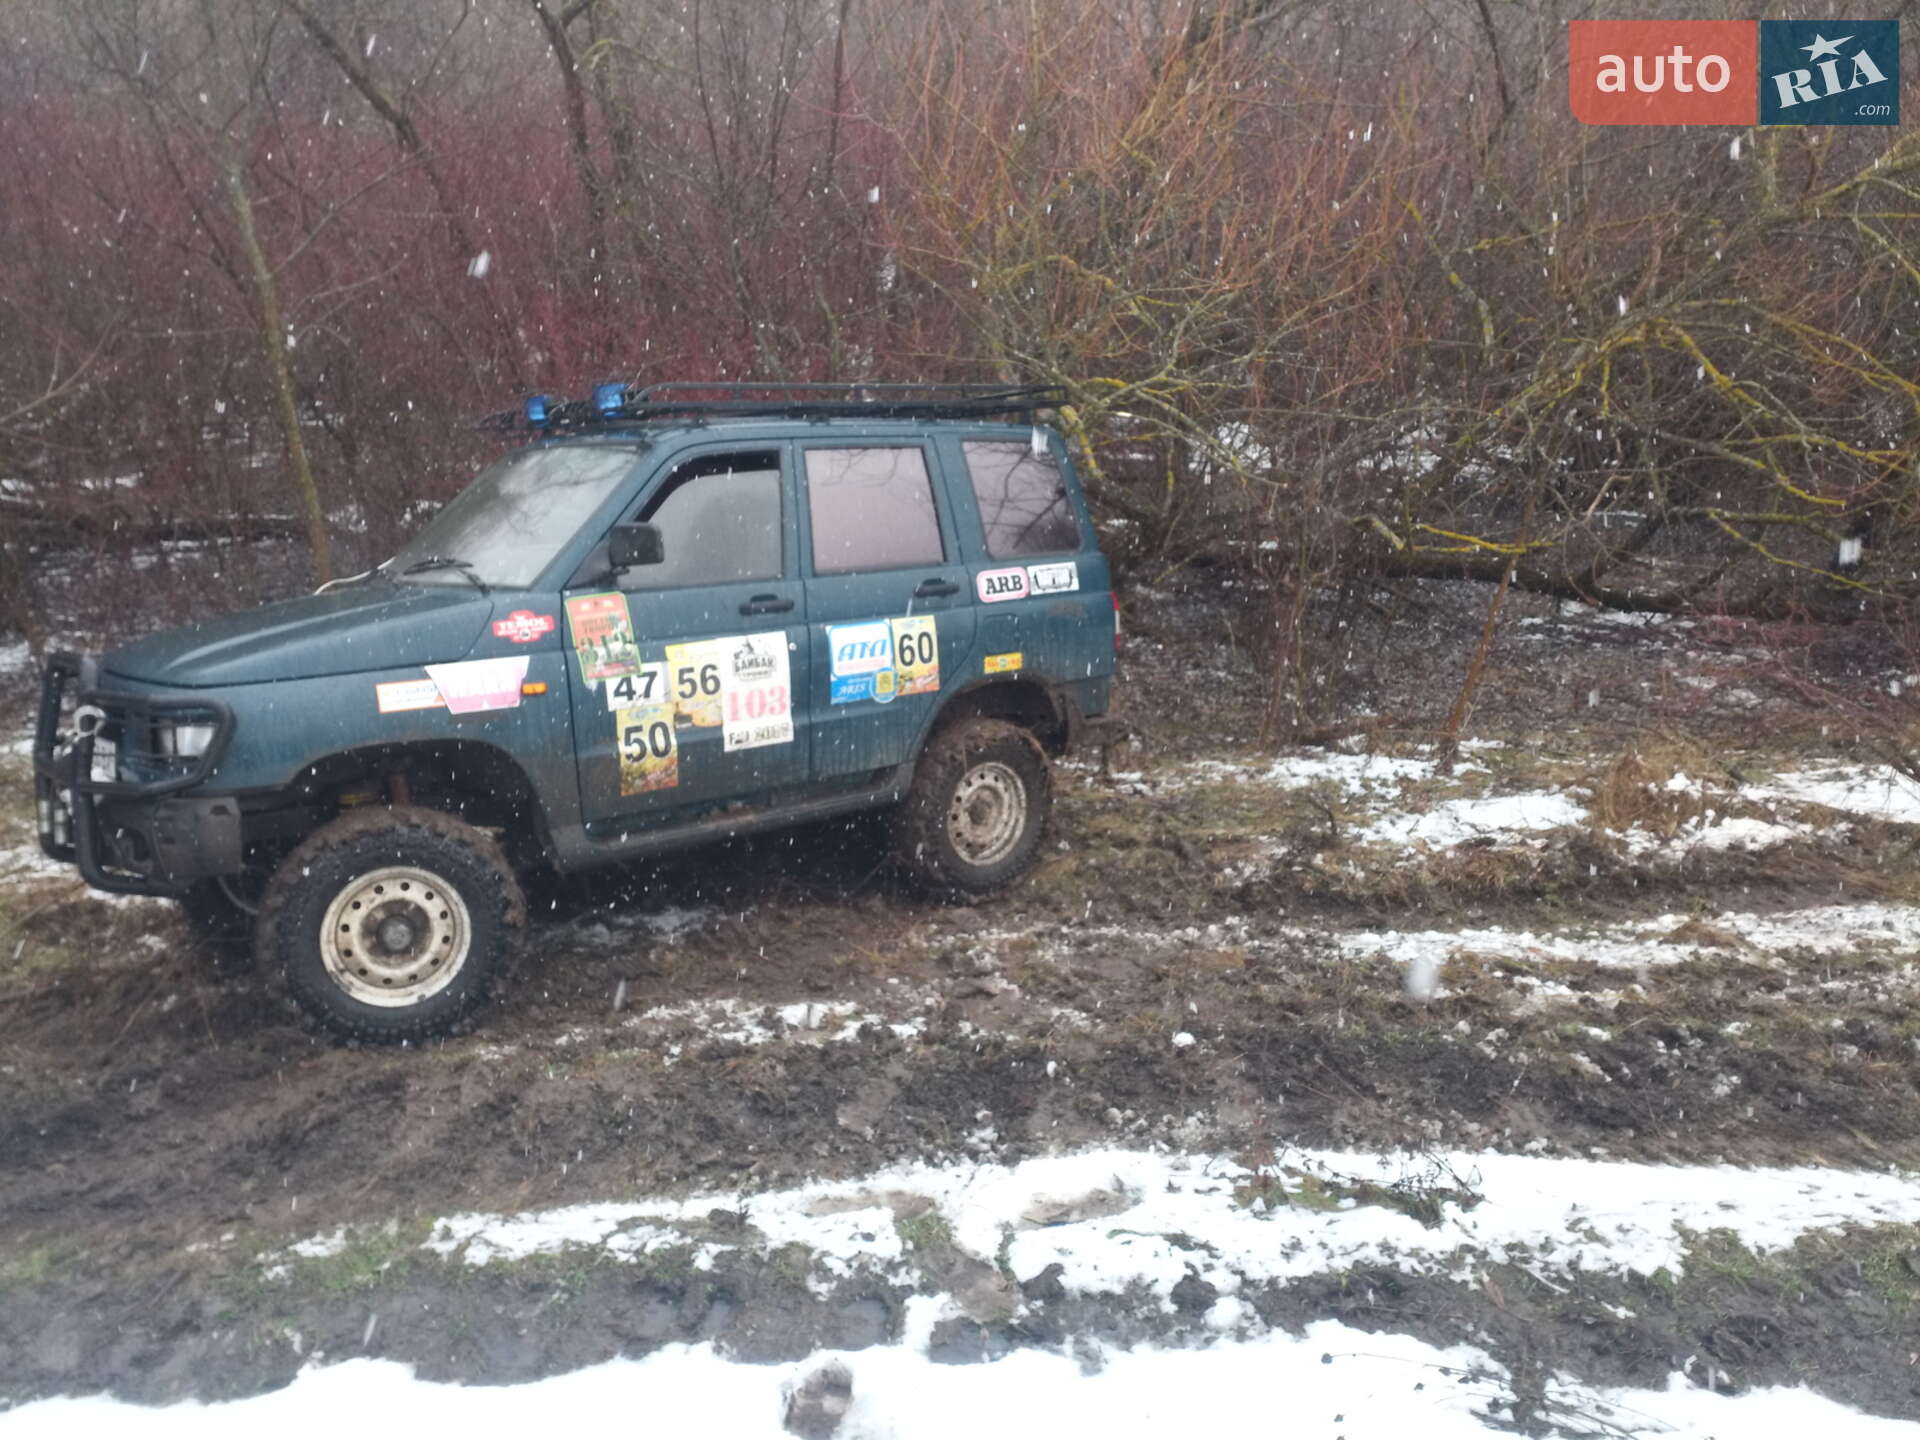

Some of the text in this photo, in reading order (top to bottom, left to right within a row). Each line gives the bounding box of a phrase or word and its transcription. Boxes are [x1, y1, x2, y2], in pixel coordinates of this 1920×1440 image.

[985, 574, 1023, 595] ARB
[899, 631, 934, 667] 60
[613, 670, 658, 701] 47
[677, 664, 721, 699] 56
[727, 685, 788, 722] 103
[623, 721, 672, 763] 50
